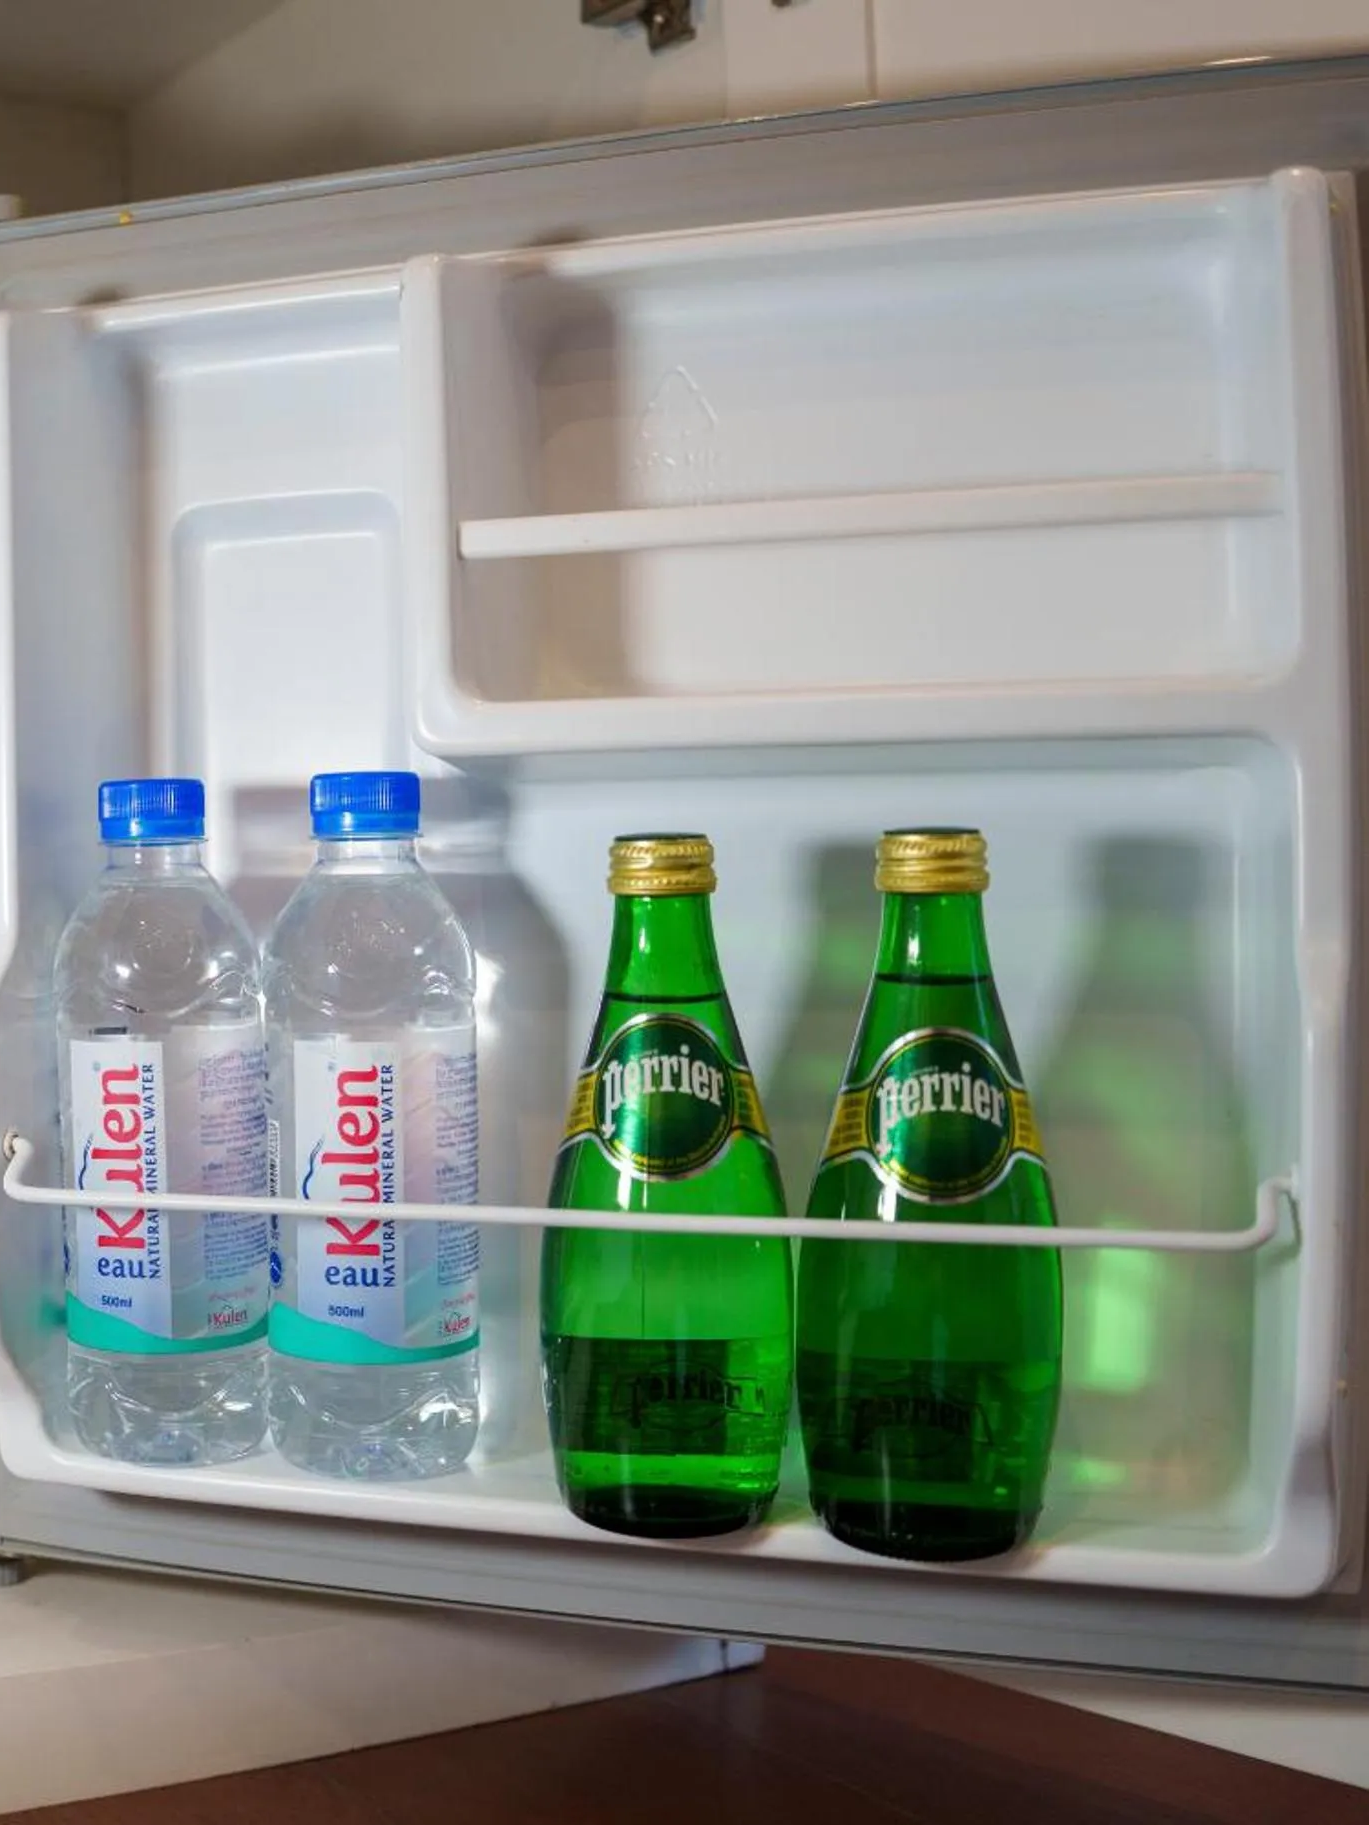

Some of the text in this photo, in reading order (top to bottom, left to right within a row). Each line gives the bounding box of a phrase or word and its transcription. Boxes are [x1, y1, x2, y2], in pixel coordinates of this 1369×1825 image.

[141, 1063, 156, 1122] WATER
[90, 1062, 145, 1250] Kulen
[320, 1064, 381, 1257] Kulen
[380, 1064, 396, 1288] NATURA MINERAL WATER
[97, 1257, 147, 1280] eau
[325, 1265, 381, 1288] eau
[328, 1305, 365, 1318] 500ml
